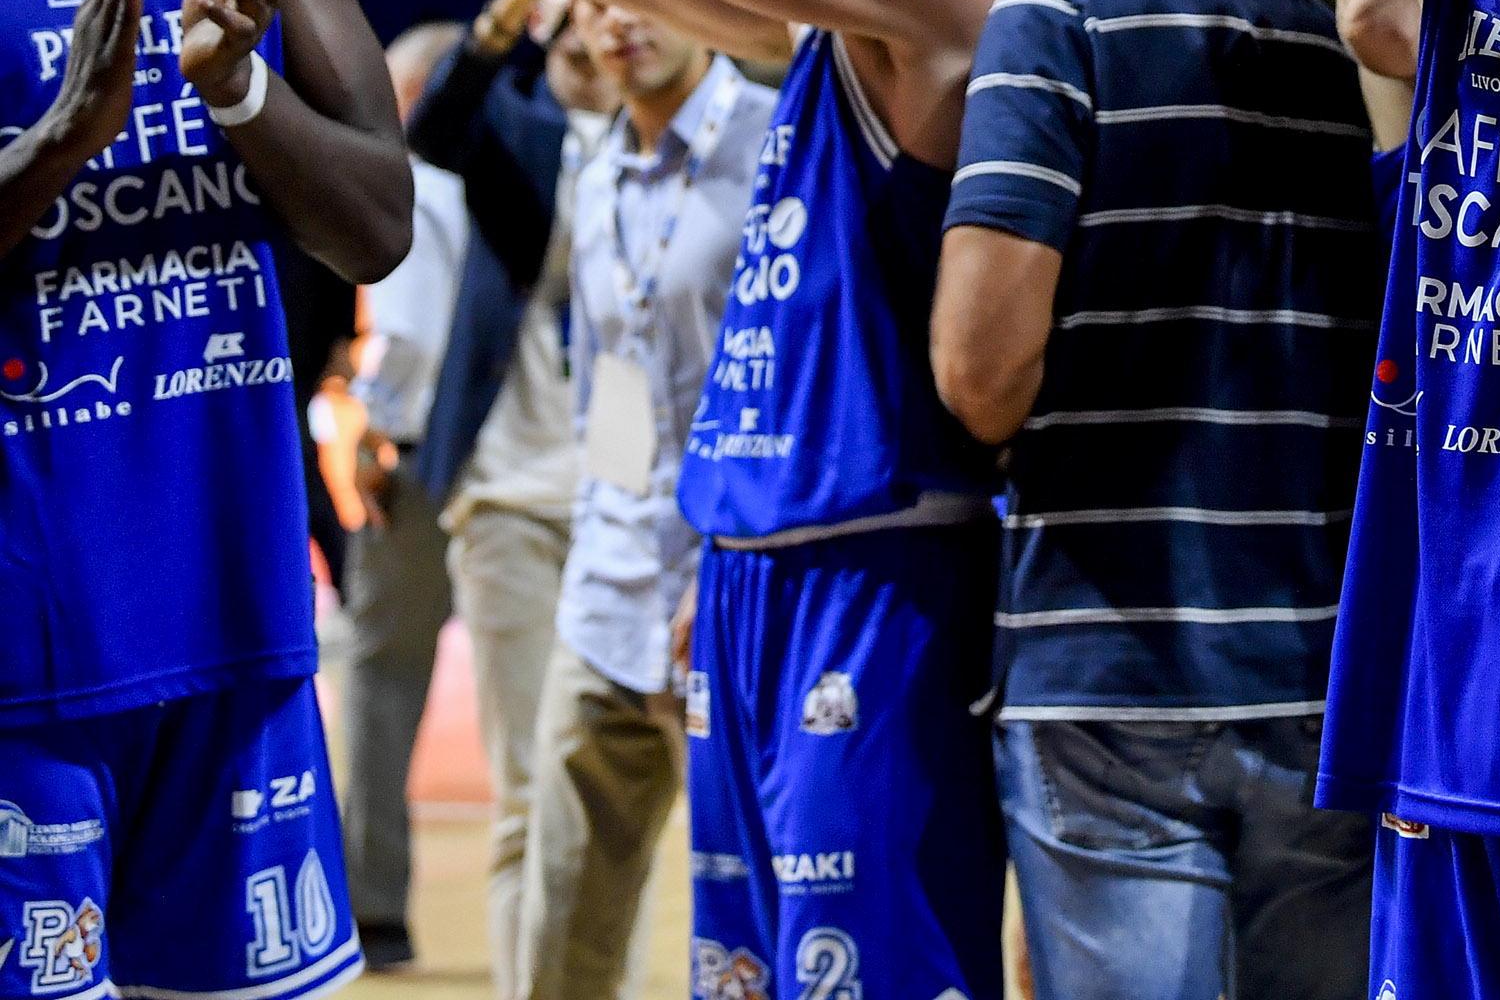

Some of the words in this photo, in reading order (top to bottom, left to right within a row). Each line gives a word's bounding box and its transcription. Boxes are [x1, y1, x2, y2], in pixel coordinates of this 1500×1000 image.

[36, 240, 259, 304] FARMACIA
[41, 275, 266, 342] FARNETI
[246, 848, 337, 978] 10
[796, 926, 864, 1000] 2
